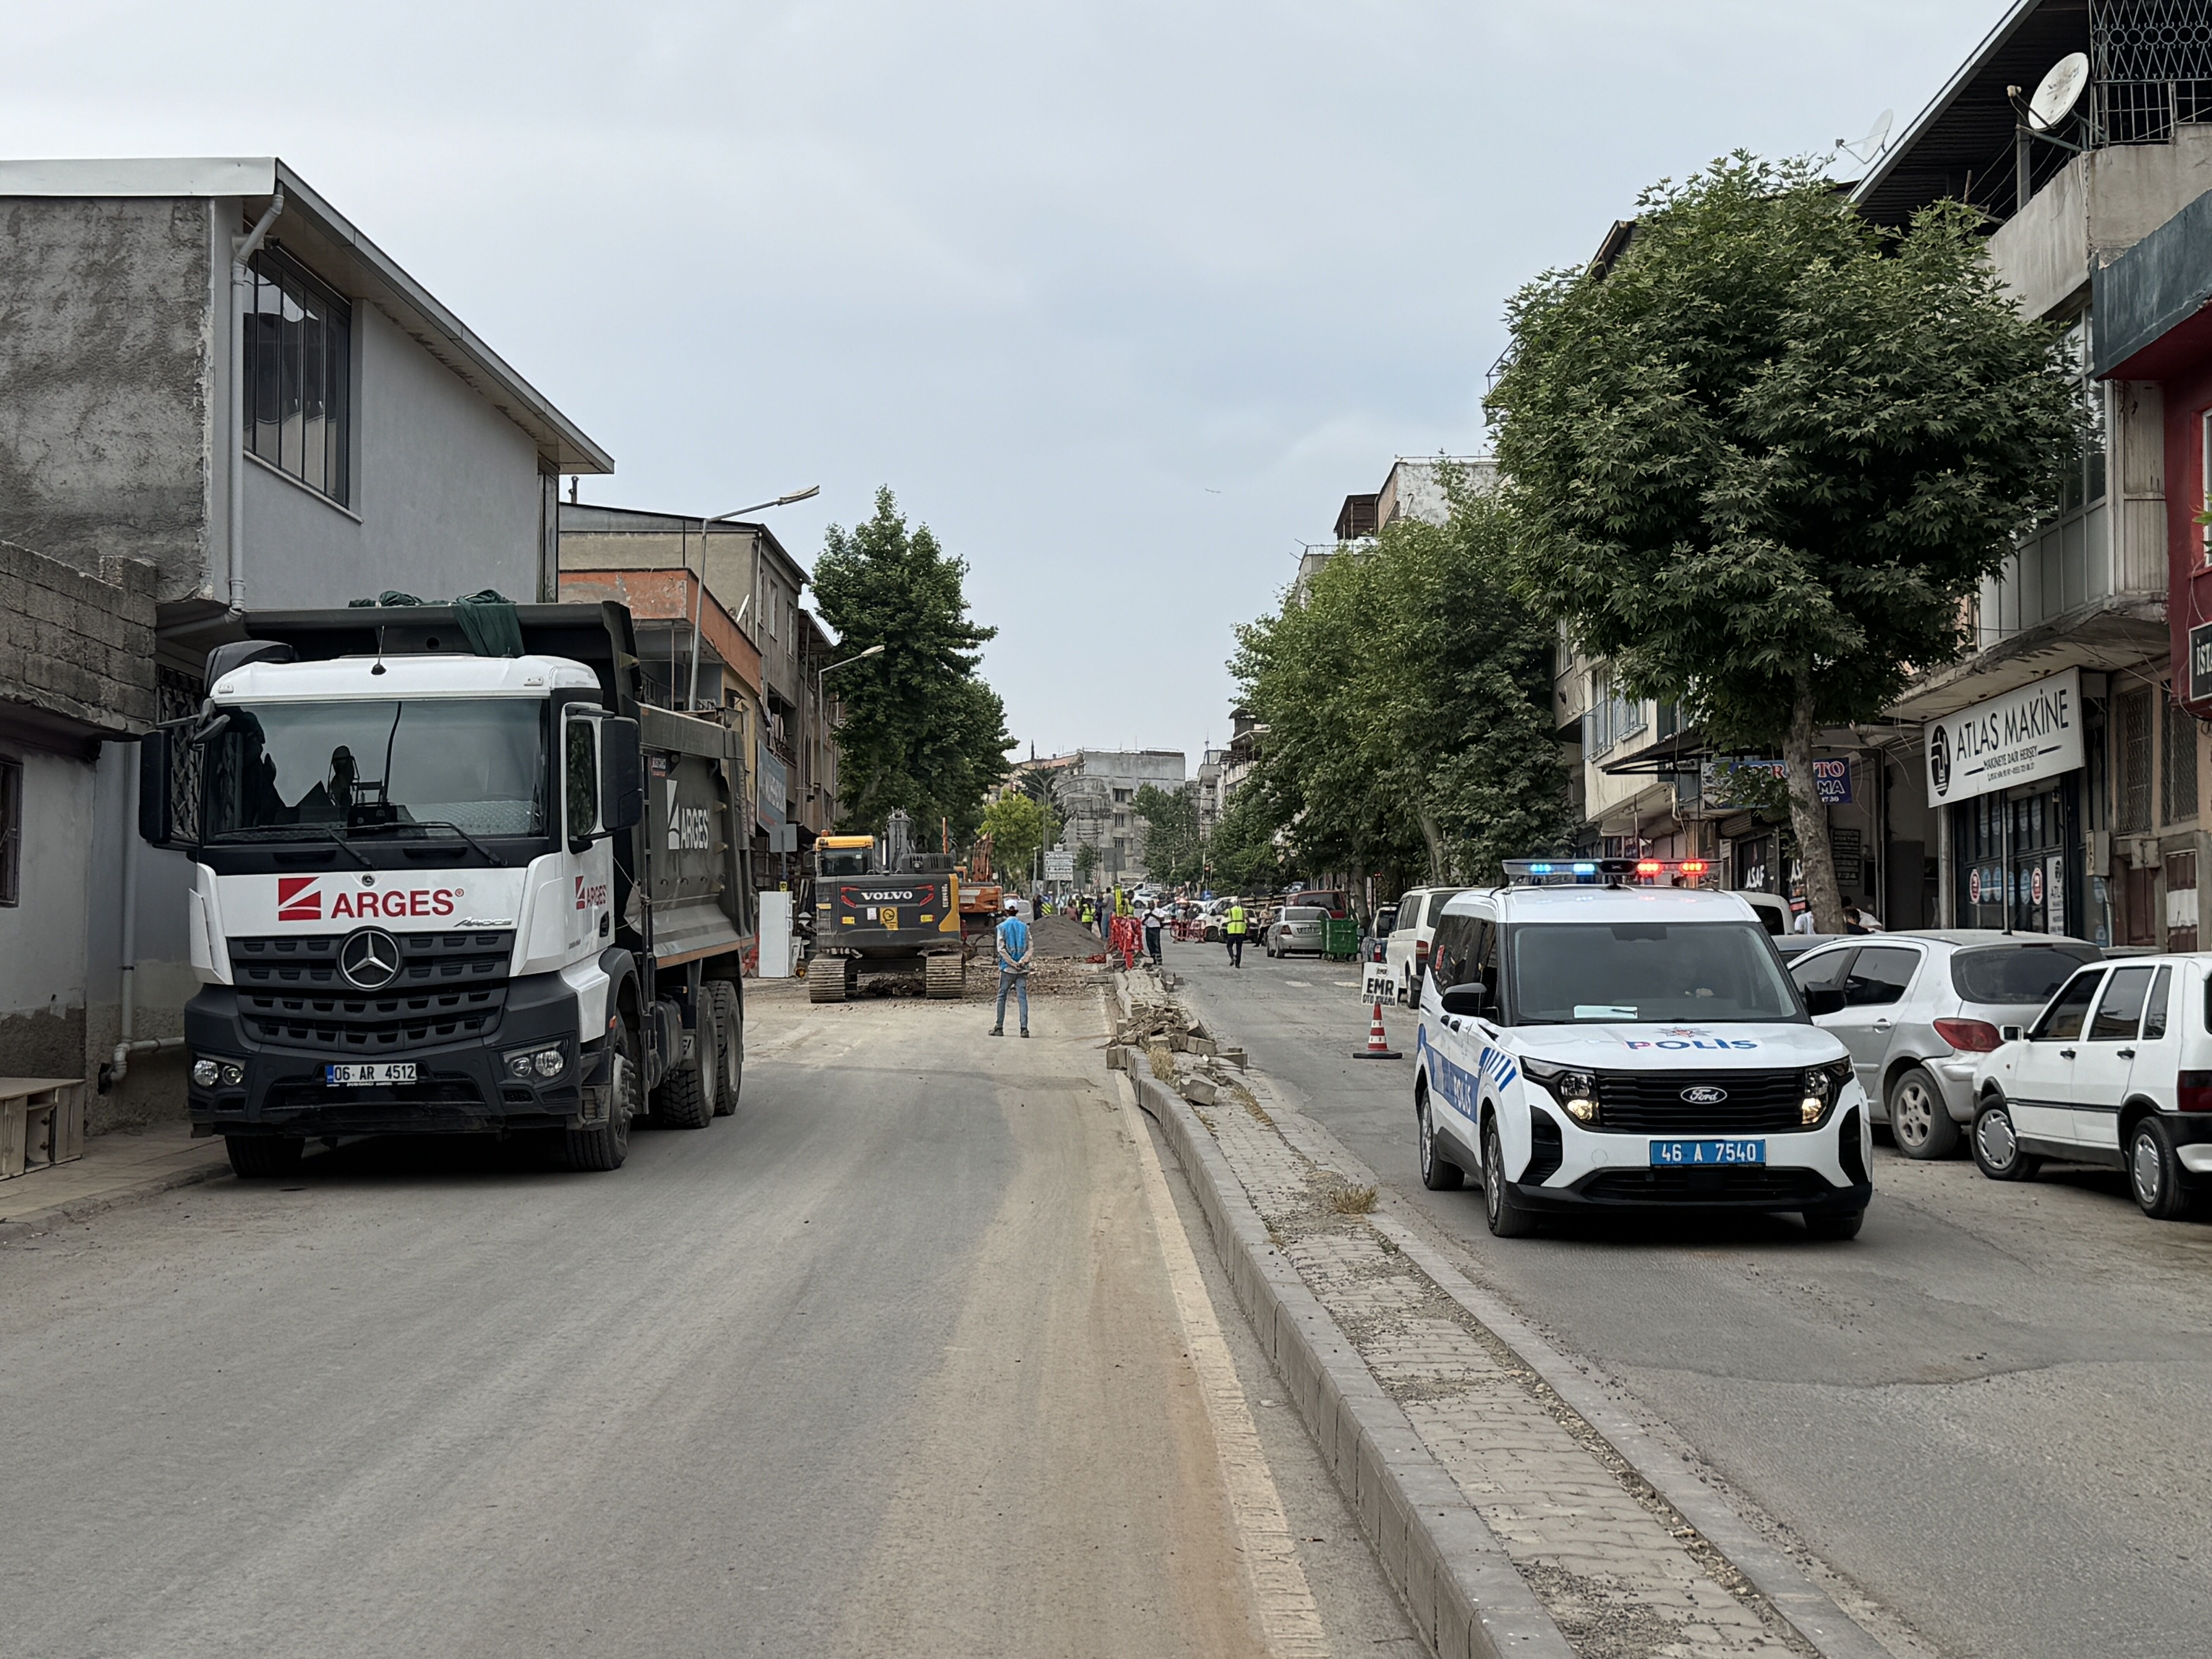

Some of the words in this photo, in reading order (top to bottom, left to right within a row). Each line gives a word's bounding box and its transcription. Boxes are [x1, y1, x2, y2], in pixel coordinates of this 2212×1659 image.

[1957, 713, 1999, 761] ATLAS
[2004, 689, 2069, 746] MAKİNE
[1813, 761, 1844, 777] TO
[1817, 780, 1845, 795] MA
[681, 808, 709, 849] ARGES
[1745, 865, 1765, 888] ASAF
[331, 889, 454, 919] ARGES
[861, 891, 913, 900] VOLVO
[1366, 978, 1394, 996] EMR
[1625, 1039, 1758, 1049] POLİS
[335, 1067, 350, 1080] 06
[359, 1066, 374, 1080] AR
[385, 1066, 415, 1079] 4512
[1690, 1089, 1719, 1101] Ford
[1662, 1143, 1682, 1162] 46
[1694, 1143, 1703, 1162] A
[1716, 1143, 1756, 1162] 7540
